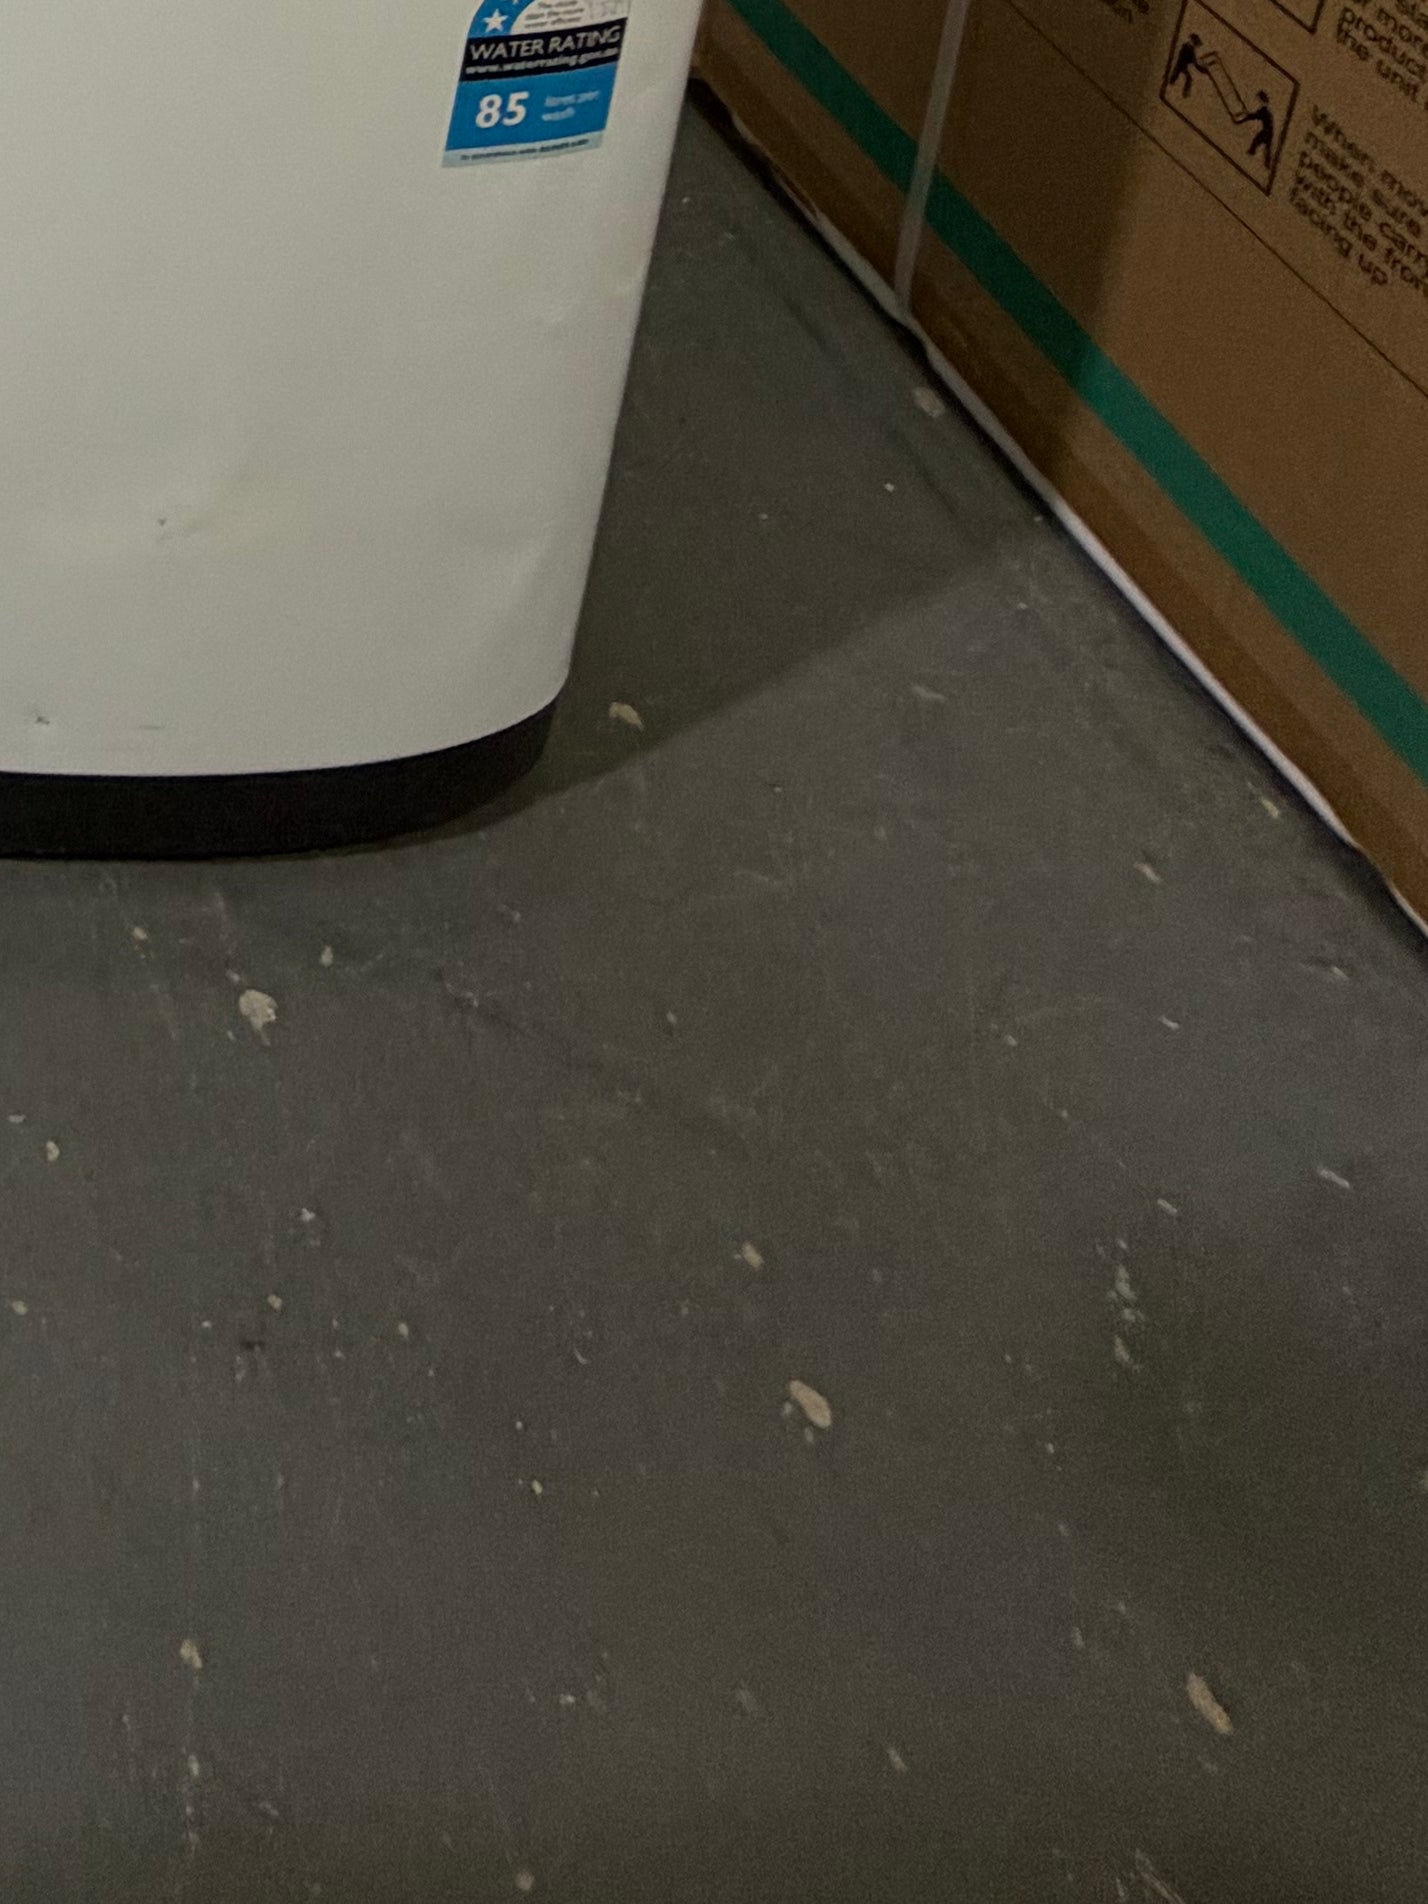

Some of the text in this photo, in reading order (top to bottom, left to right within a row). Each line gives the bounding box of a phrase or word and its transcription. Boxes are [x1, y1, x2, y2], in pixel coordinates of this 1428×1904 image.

[470, 24, 622, 61] WATER RATING
[475, 91, 530, 129] 85
